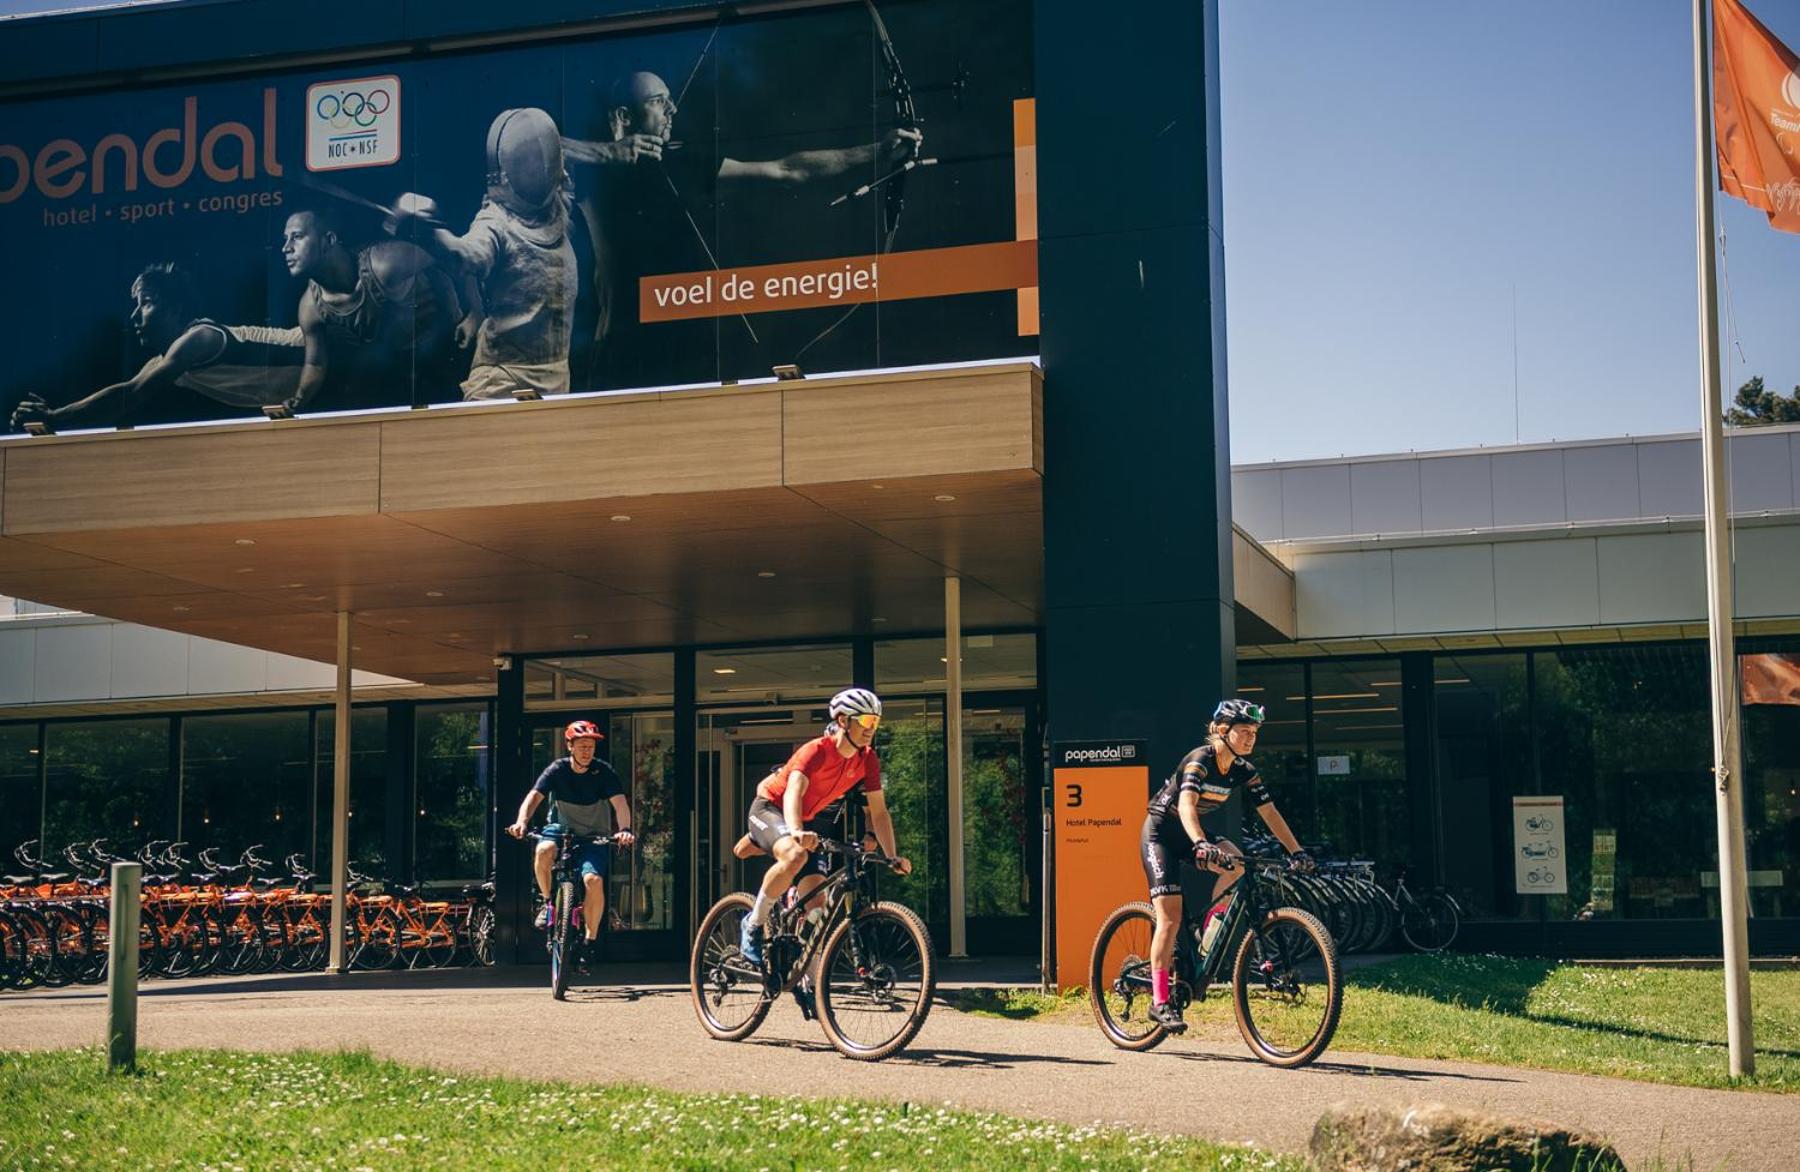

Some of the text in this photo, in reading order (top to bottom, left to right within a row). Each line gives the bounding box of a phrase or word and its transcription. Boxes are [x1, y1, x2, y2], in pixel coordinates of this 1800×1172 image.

[1770, 112, 1800, 133] Team
[43, 190, 283, 227] hotel sport congres
[654, 262, 878, 307] voel de energie!
[1065, 745, 1121, 763] papendal
[1066, 784, 1082, 808] 3
[1066, 817, 1122, 829] Hotel Papendal
